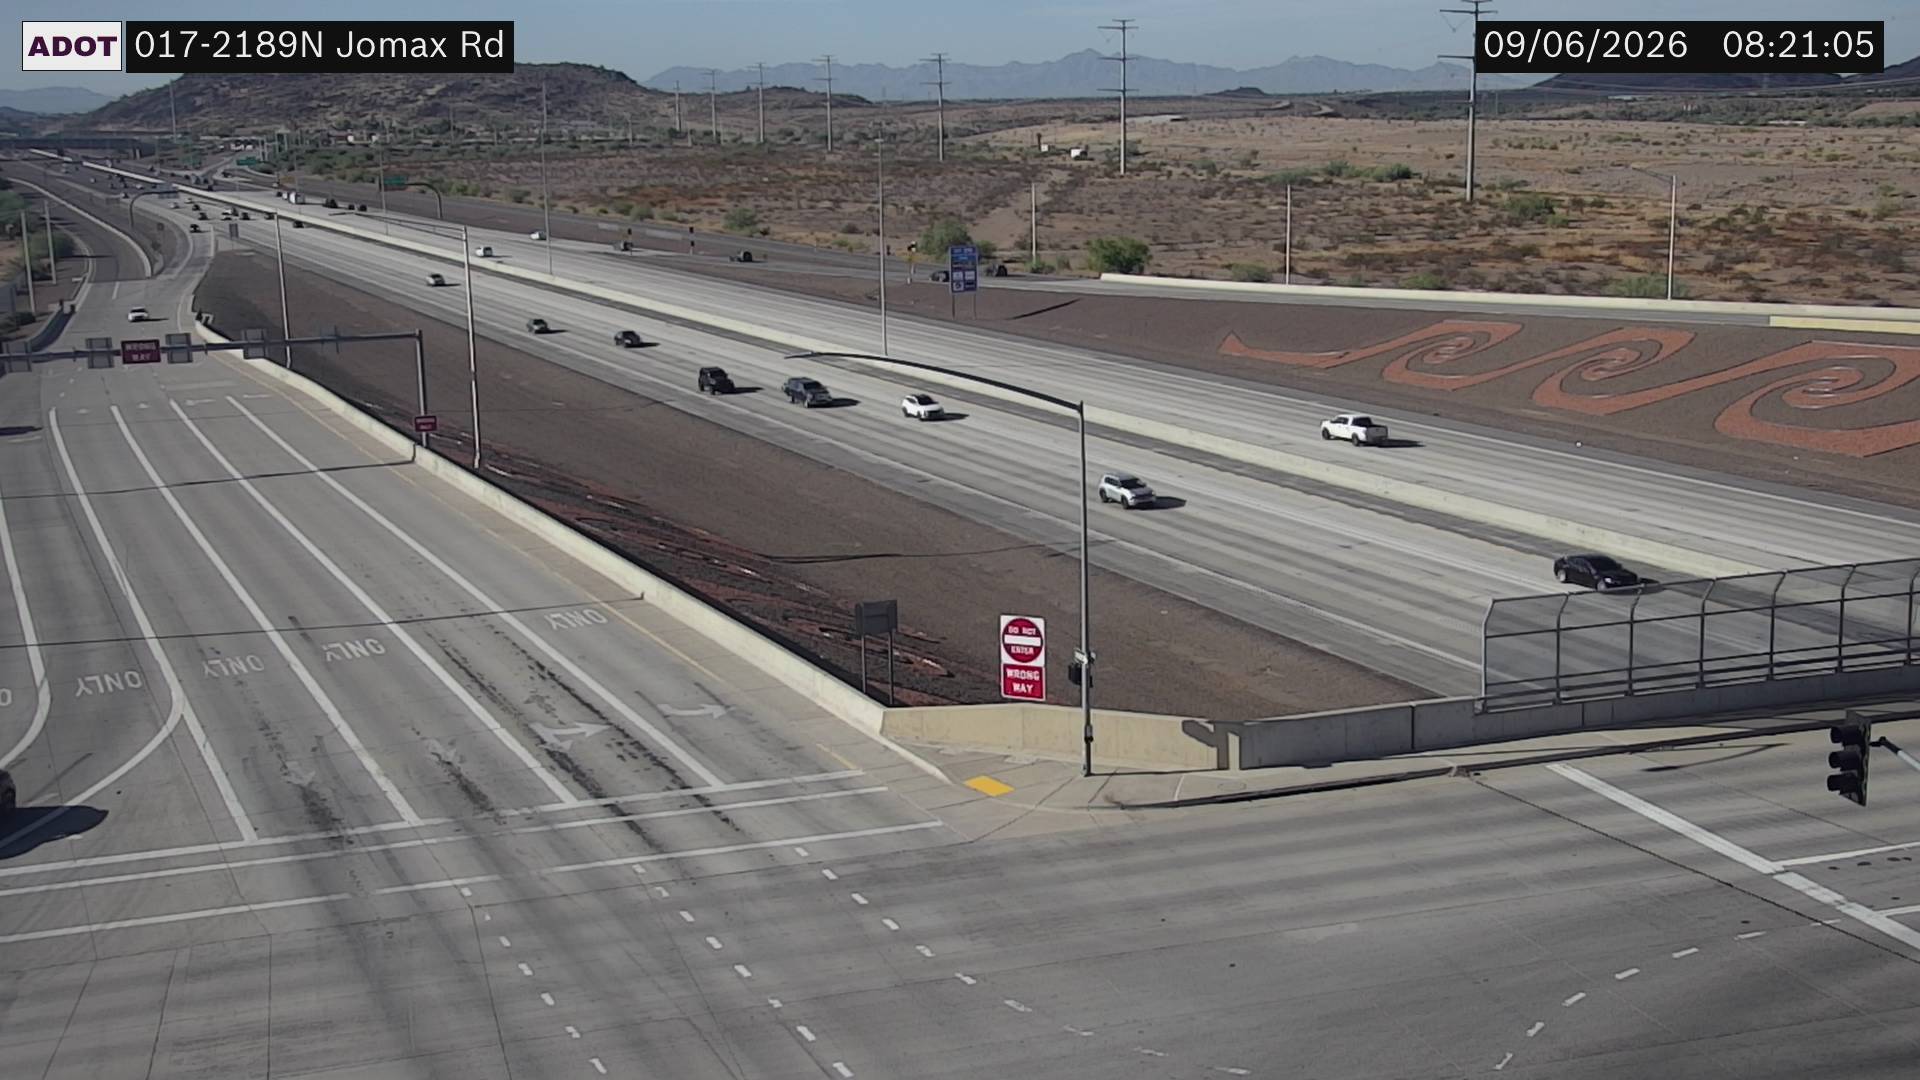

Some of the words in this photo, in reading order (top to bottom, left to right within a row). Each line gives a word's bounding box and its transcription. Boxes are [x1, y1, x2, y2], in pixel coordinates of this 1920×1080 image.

[543, 609, 609, 630] ONLY
[1008, 626, 1019, 634] DO
[1022, 627, 1037, 635] NOT
[322, 638, 386, 662] ONLY
[1010, 646, 1034, 655] ENTER
[202, 655, 265, 678] ONLY
[1006, 668, 1040, 681] WRONG
[75, 670, 142, 697] ONLY
[1012, 682, 1034, 694] WAY
